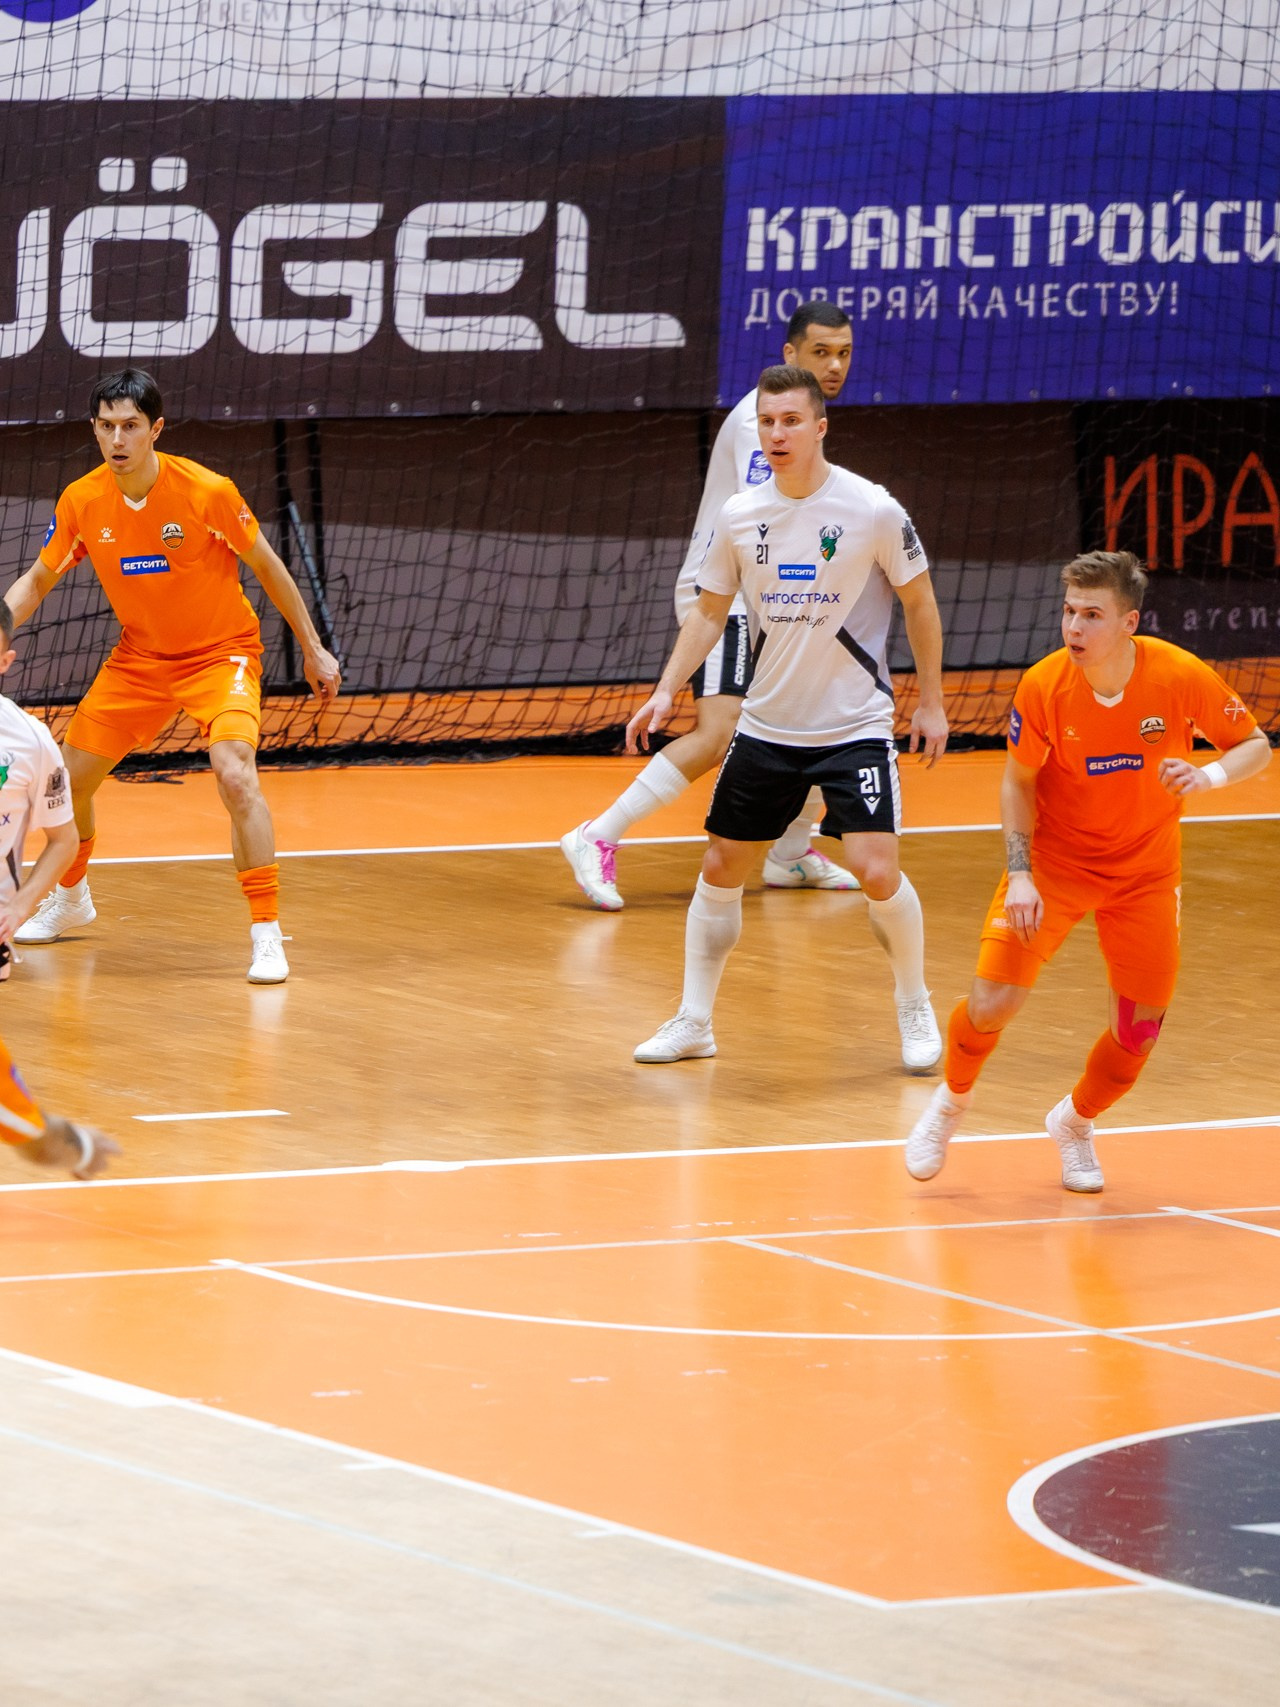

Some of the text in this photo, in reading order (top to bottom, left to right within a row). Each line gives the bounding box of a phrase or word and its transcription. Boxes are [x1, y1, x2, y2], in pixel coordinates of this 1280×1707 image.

[958, 281, 1178, 319] КАЧЕСТВУ!
[123, 560, 168, 570] БЕТСИТИ
[757, 544, 768, 564] 21
[760, 592, 841, 605] ИНГОССТРАХ
[1183, 607, 1280, 631] aren
[735, 615, 747, 686] CORDIANT
[230, 656, 248, 680] 7
[1089, 758, 1142, 770] БЕТСИТИ
[859, 766, 880, 794] 21
